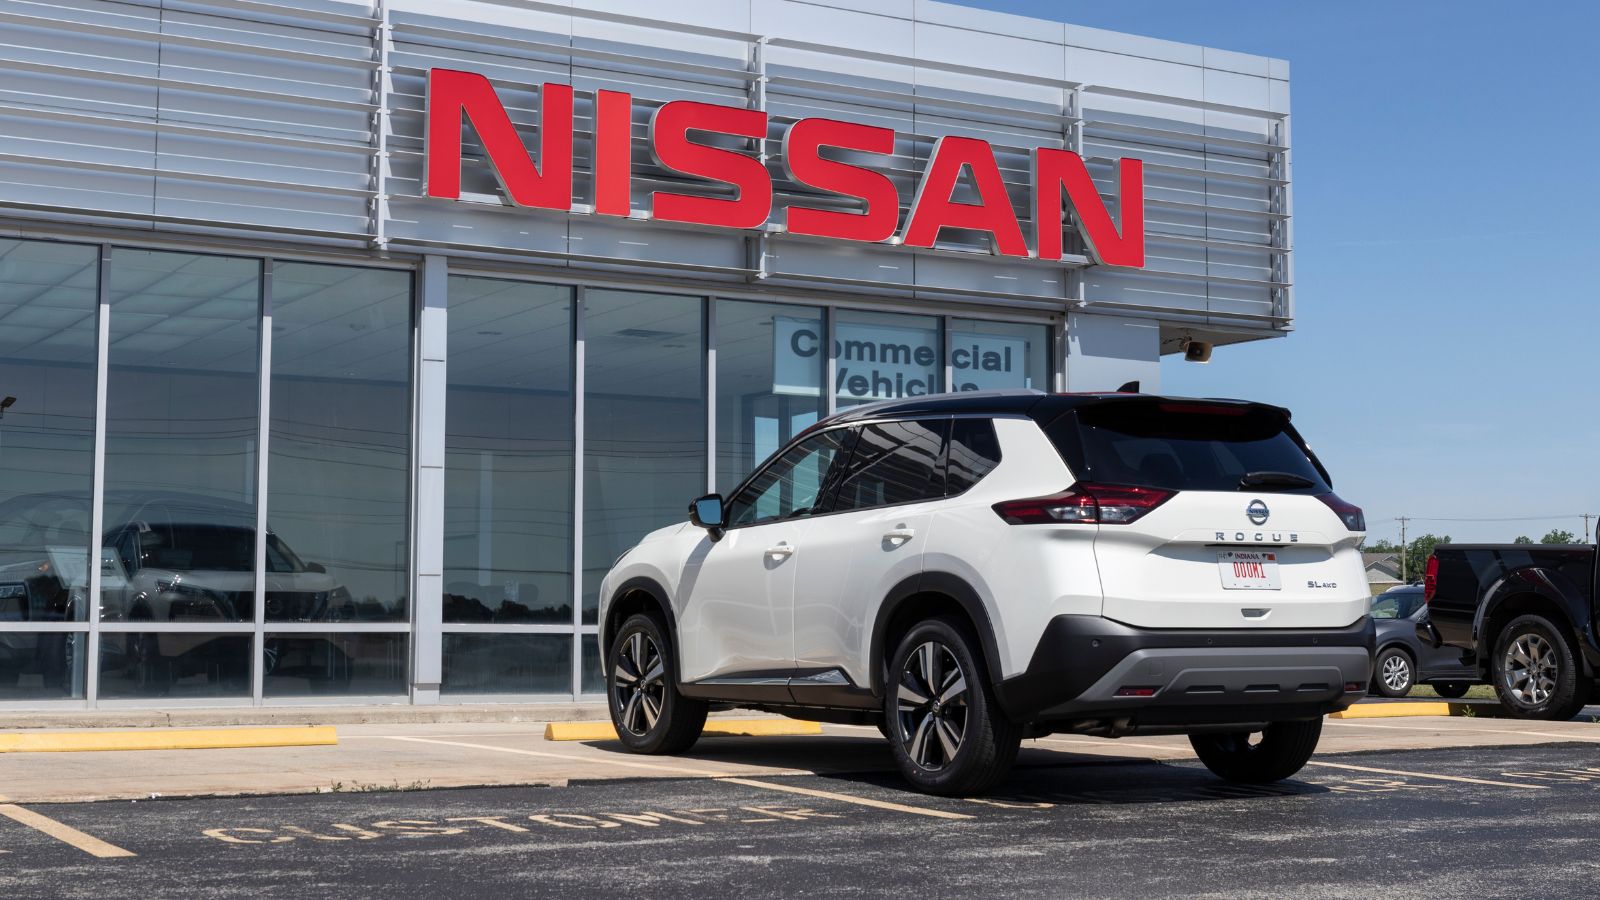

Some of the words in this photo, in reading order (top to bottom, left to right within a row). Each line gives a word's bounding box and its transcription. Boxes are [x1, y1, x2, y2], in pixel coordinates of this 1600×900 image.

[427, 68, 1146, 269] NISSAN
[790, 329, 1012, 373] Cmmecial
[835, 367, 979, 398] Vehicl
[1215, 531, 1298, 543] ROGUE
[1307, 580, 1322, 588] SL
[202, 806, 846, 844] CUSTOMER
